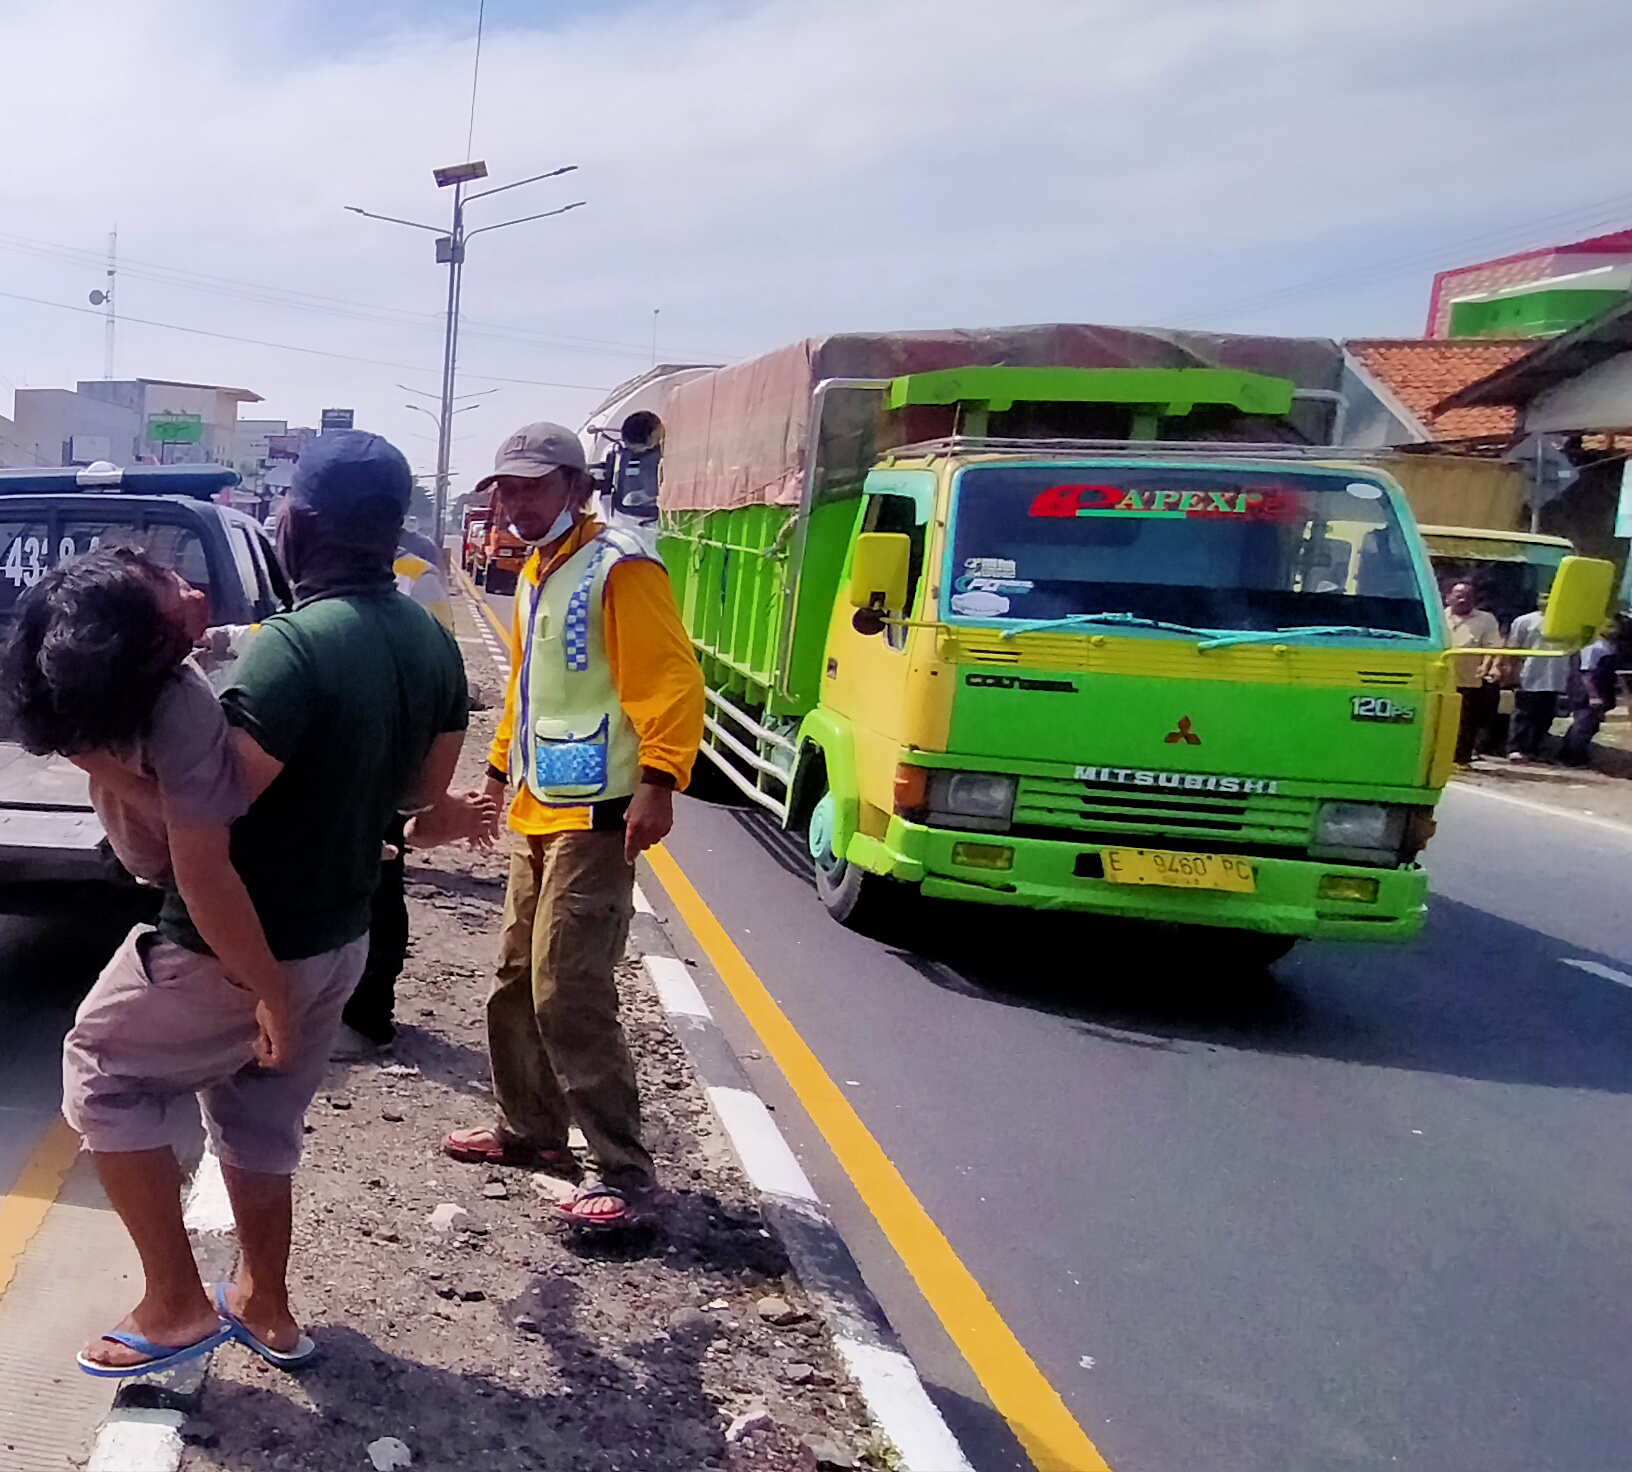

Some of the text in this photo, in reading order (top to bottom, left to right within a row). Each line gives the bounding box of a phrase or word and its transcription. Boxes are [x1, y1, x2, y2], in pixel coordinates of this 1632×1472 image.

[1073, 765, 1278, 794] MITSUBISHI
[1106, 851, 1251, 880] E 9460 PC
